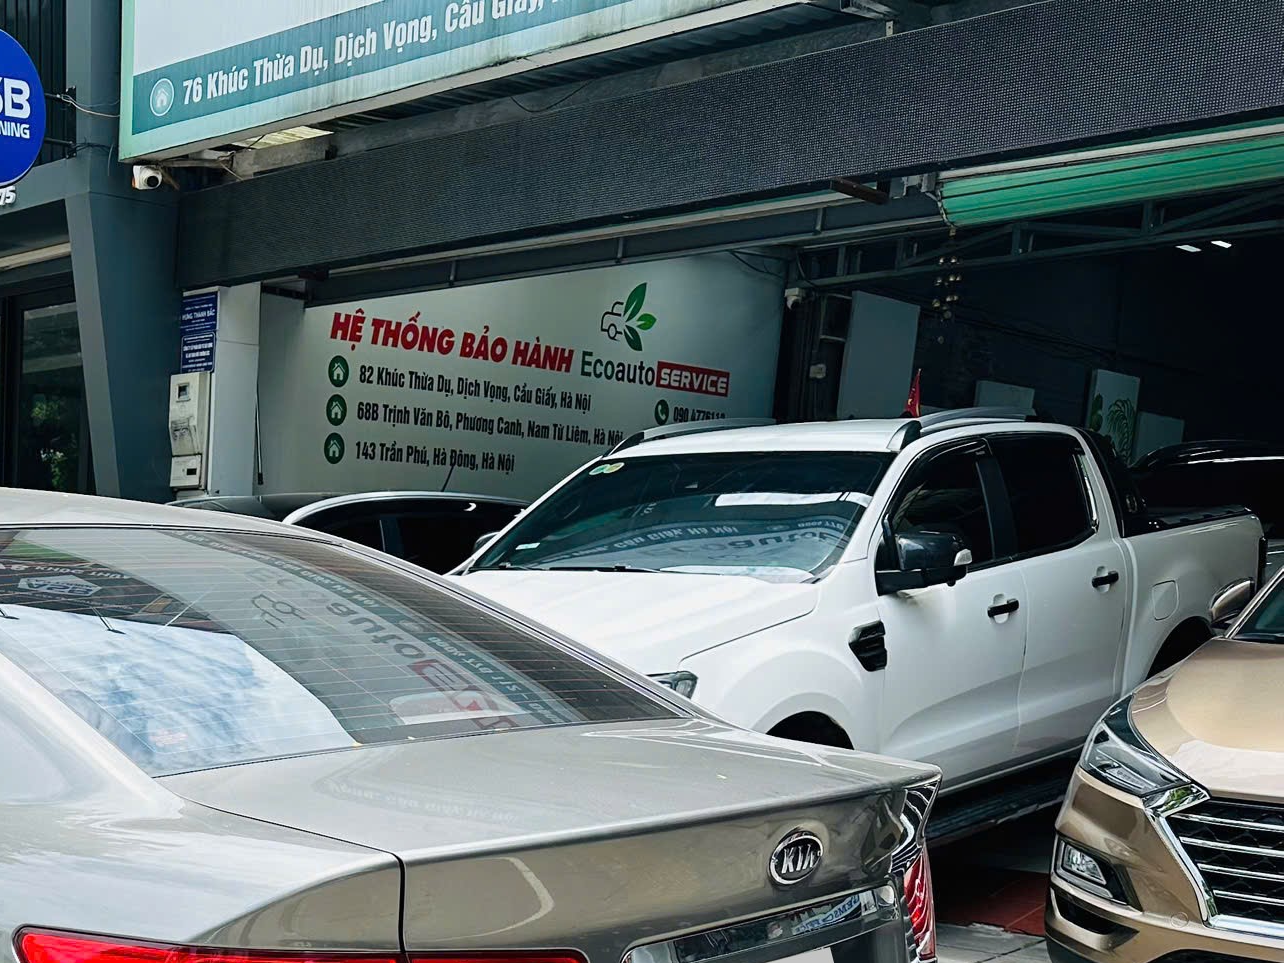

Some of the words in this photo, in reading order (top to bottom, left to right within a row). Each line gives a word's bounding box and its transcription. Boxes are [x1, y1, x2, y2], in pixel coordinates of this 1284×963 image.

[182, 76, 203, 105] 76
[207, 65, 249, 100] Khúc
[254, 52, 295, 87] Thừa
[300, 45, 328, 76] Dụ,
[335, 27, 377, 66] Dịch
[383, 14, 437, 53] Vọng,
[330, 308, 367, 352] HỆ
[371, 311, 456, 355] THỐNG
[460, 325, 508, 363] BẢO
[512, 336, 574, 373] HÀNH
[359, 365, 374, 385] 82
[377, 366, 405, 388] Khúc
[408, 370, 434, 392] Thừa
[437, 376, 454, 398] Dụ,
[457, 377, 481, 398] Dịch
[483, 380, 511, 403] Vọng,
[514, 382, 533, 403] Cầu
[535, 387, 557, 410] Giấy,
[560, 391, 573, 408] Hà
[575, 393, 592, 412] Nội
[580, 350, 655, 386] Ecoauto
[660, 368, 728, 394] SERVICE
[357, 401, 379, 421] 68B
[383, 403, 410, 427] Trịnh
[413, 407, 433, 426] Văn
[436, 410, 453, 431] Bô,
[456, 412, 494, 435] Phương
[497, 416, 524, 438] Canh,
[527, 420, 550, 440] Nam
[553, 421, 564, 441] Từ
[565, 425, 591, 446] Liêm,
[594, 428, 606, 446] Hà
[355, 441, 376, 461] 143
[379, 441, 403, 463] Trần
[406, 444, 430, 467] Phú,
[433, 447, 446, 466] Hà
[449, 450, 479, 471] Đông,
[482, 451, 494, 470] Hà
[497, 453, 515, 473] Nội
[781, 843, 815, 875] KIA
